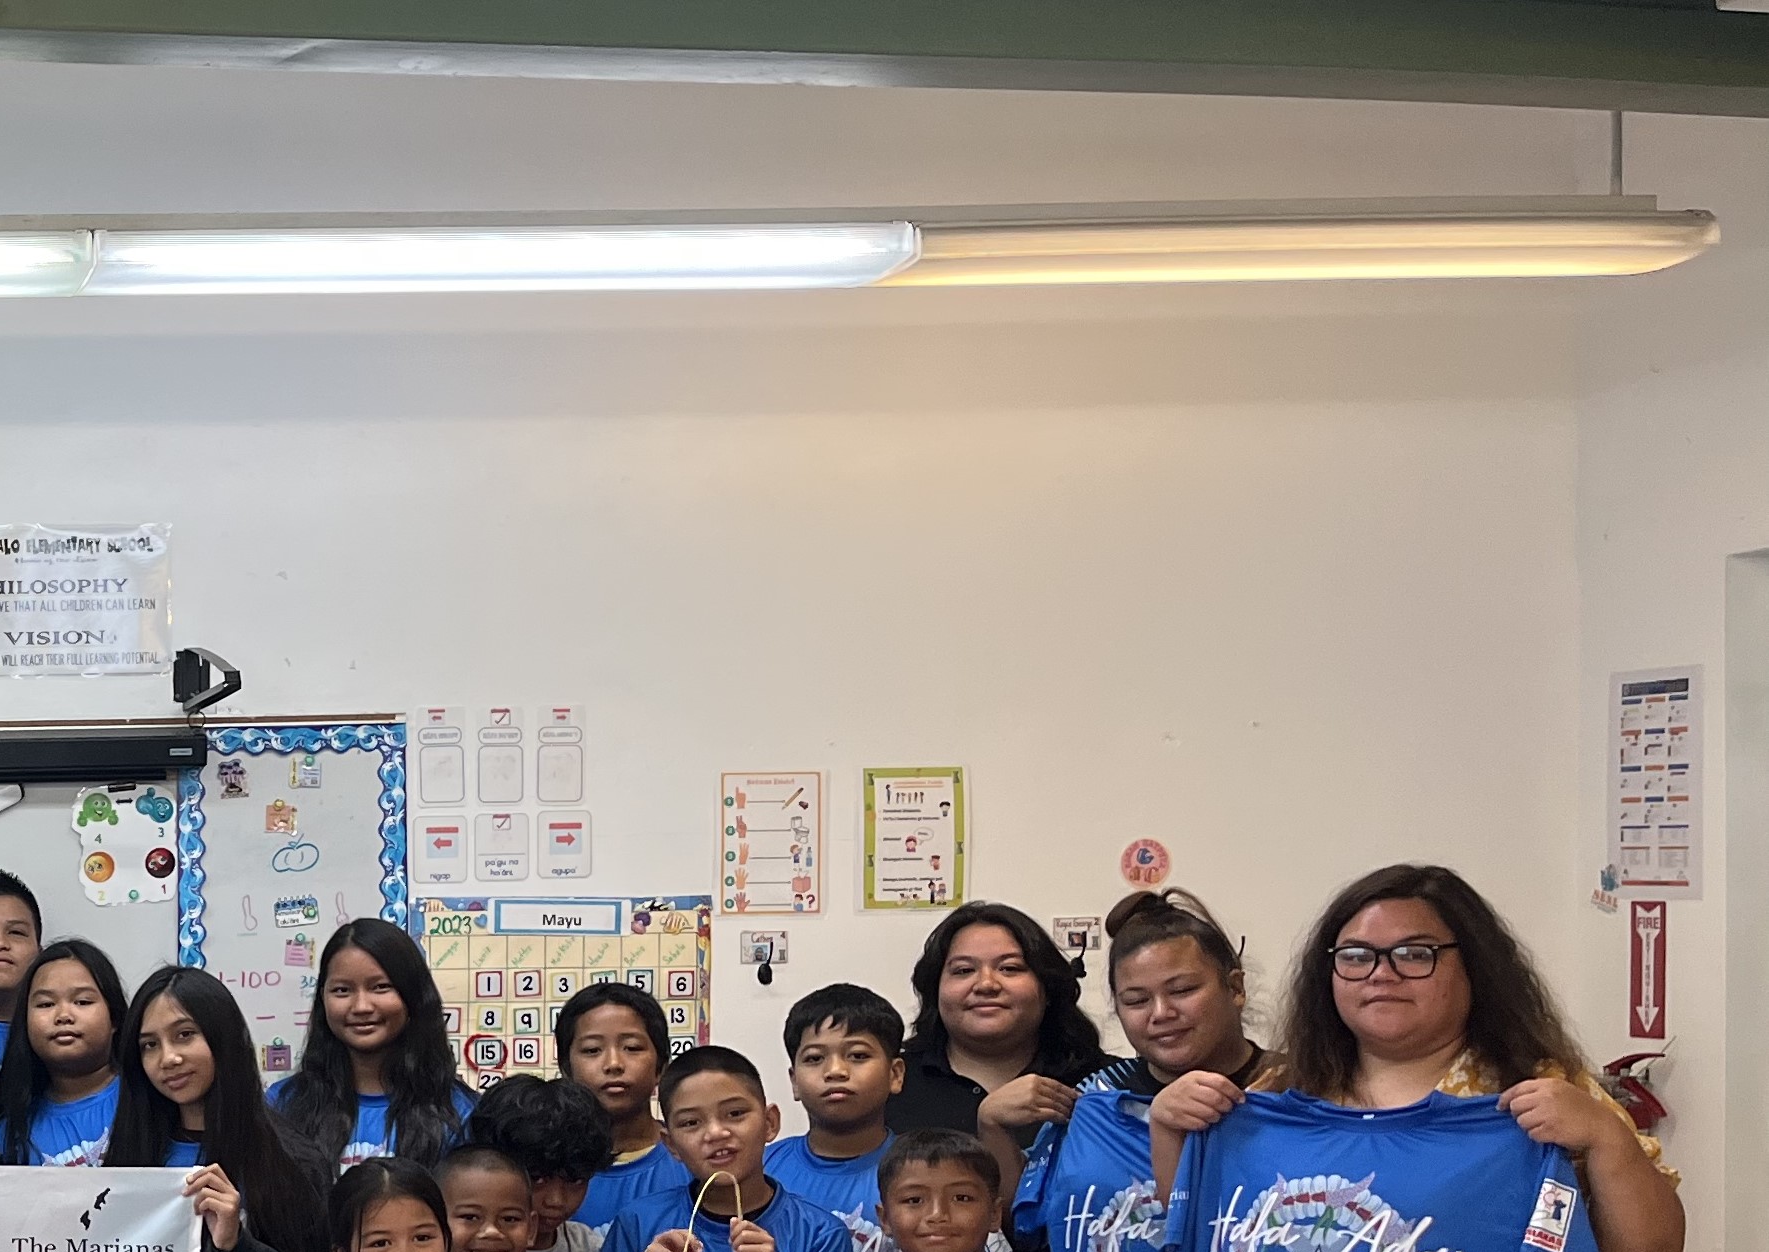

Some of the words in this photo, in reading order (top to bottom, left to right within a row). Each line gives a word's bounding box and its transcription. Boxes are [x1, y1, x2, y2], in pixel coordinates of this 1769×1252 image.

[26, 536, 101, 555] ELEMENTARY
[14, 600, 36, 612] THAT
[40, 599, 56, 611] ALL
[60, 599, 103, 611] CHILDREN
[105, 598, 124, 610] CAN
[127, 598, 156, 610] LEARN
[4, 630, 105, 646] VISION
[1, 654, 18, 666] WILL
[21, 653, 44, 665] REACH
[46, 653, 65, 665] THEIR
[67, 653, 83, 665] FULL
[85, 652, 119, 664] LEARNING
[94, 834, 102, 843] 4
[158, 827, 165, 837] 3
[430, 873, 451, 882] nigap
[161, 884, 166, 894] 1
[430, 916, 472, 935] 2023
[542, 913, 582, 928] Mayu
[1637, 917, 1660, 929] FIRE
[486, 976, 491, 992] 1
[523, 976, 533, 991] 2
[559, 977, 569, 993] 3
[635, 975, 645, 989] 5
[676, 976, 687, 991] 6
[485, 1010, 495, 1026] 8
[521, 1012, 532, 1028] 9
[670, 1008, 685, 1023] 13
[481, 1045, 496, 1060] 15
[518, 1044, 534, 1060] 16
